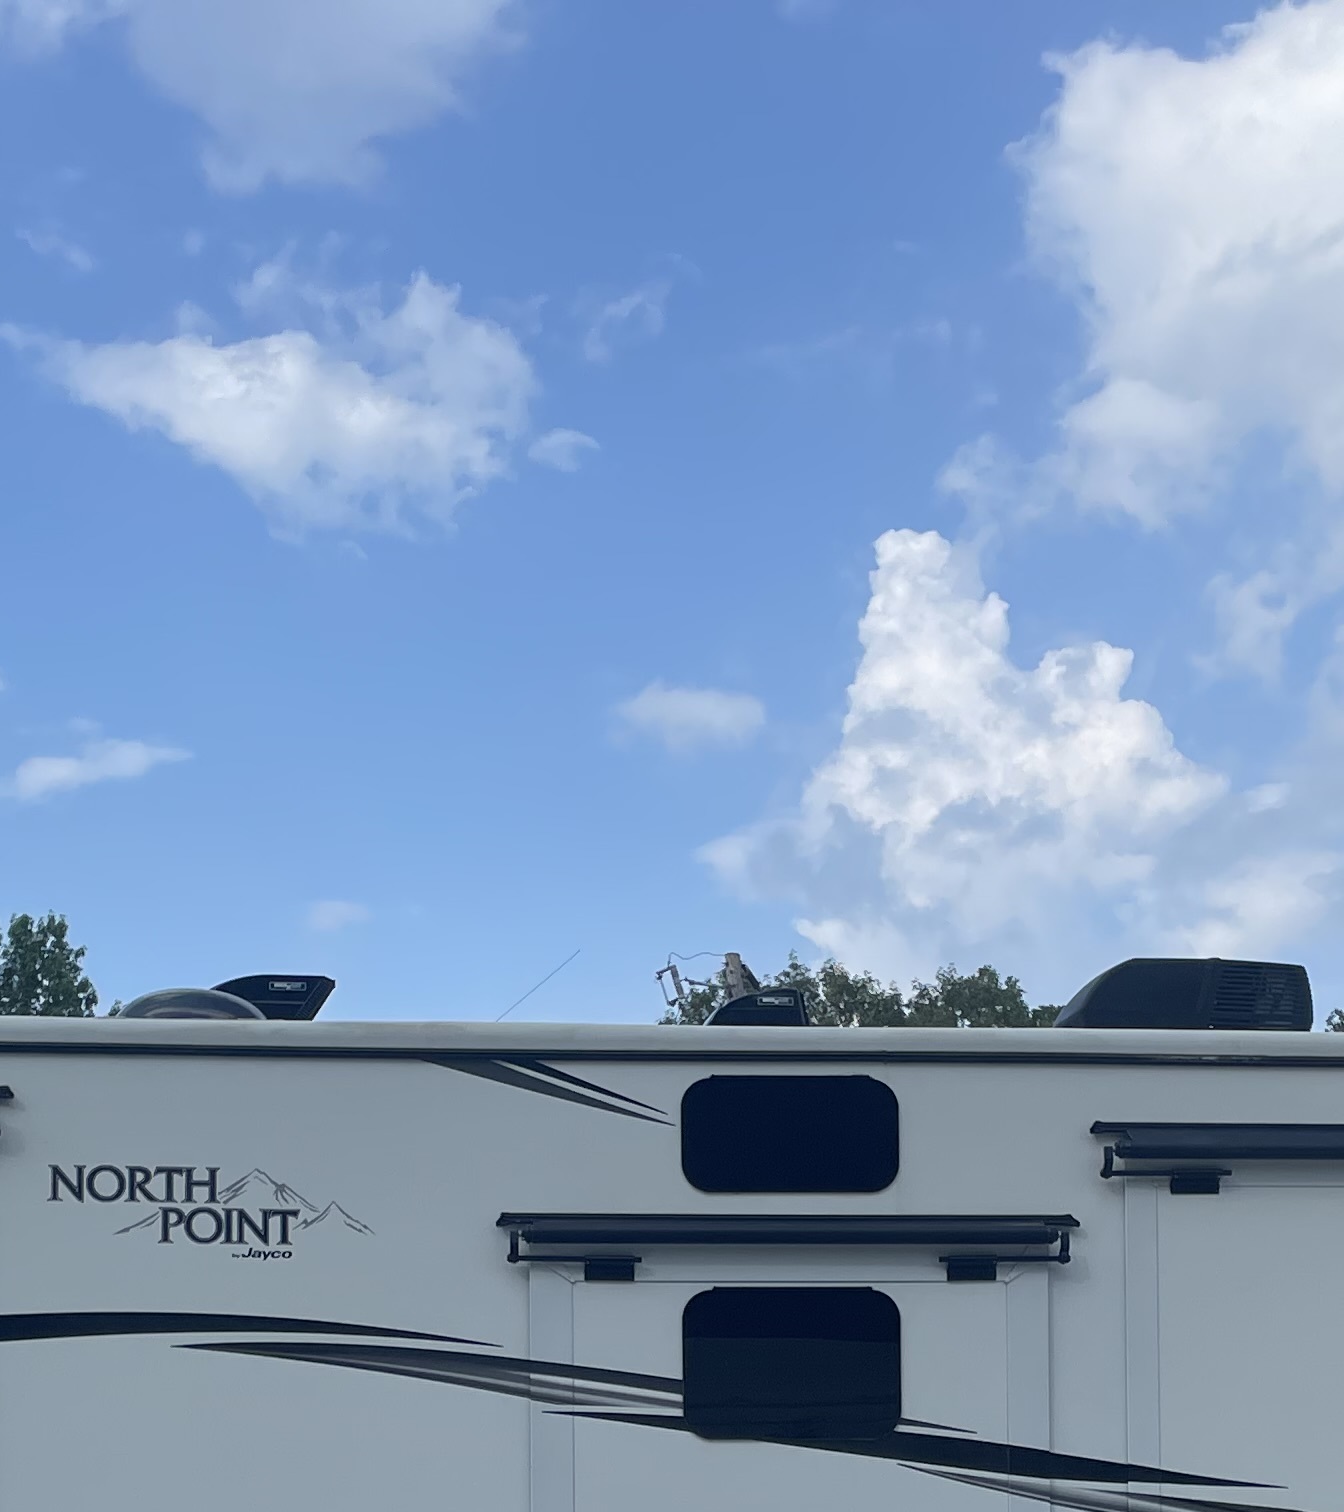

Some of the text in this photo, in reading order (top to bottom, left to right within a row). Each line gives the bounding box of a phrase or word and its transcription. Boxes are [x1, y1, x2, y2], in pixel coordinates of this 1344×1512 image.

[47, 1164, 221, 1204] NORTH
[157, 1206, 300, 1246] POINT
[241, 1247, 293, 1261] Jayco
